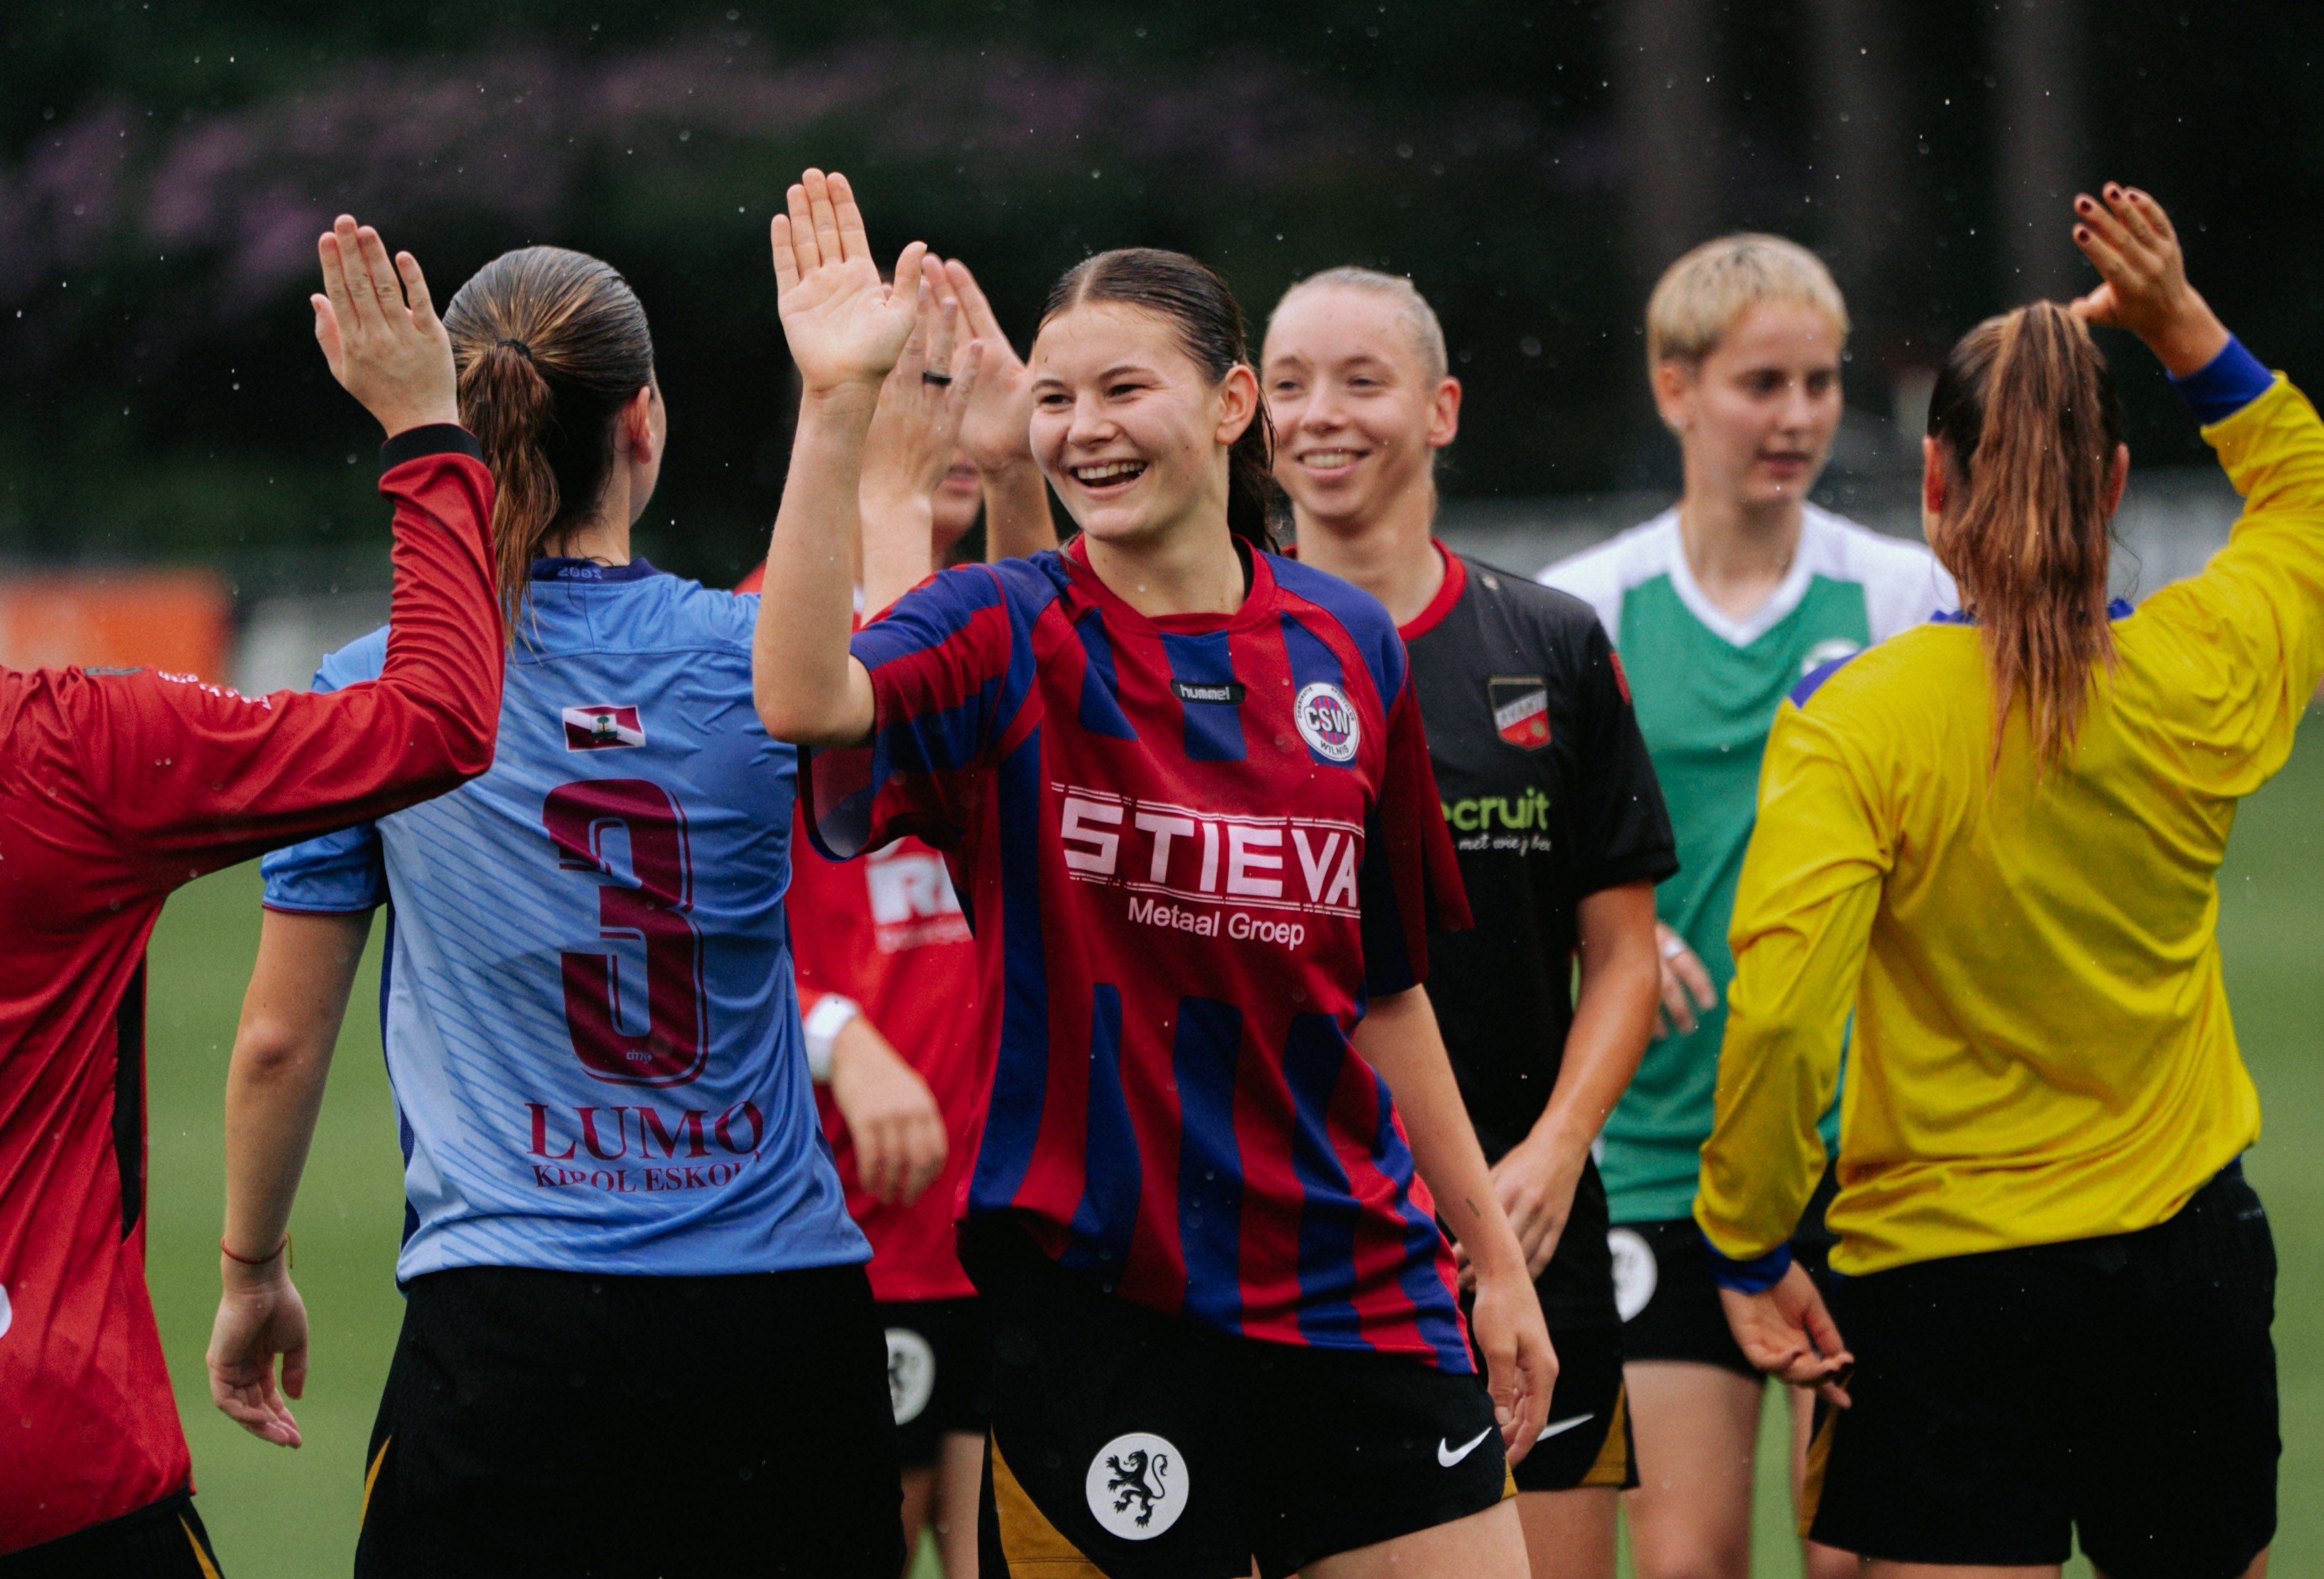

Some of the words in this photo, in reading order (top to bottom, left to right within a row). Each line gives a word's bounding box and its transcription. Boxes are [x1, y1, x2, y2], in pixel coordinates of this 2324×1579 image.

[1179, 684, 1230, 700] hummel
[1304, 706, 1350, 735] CSW
[1320, 740, 1349, 756] WILNIS
[1061, 797, 1358, 908] STIEVA
[543, 779, 709, 1089] 3
[1128, 898, 1221, 937] Metaal
[1228, 913, 1305, 951] Groep
[524, 1100, 764, 1161] LUMO
[643, 1159, 751, 1193] ESKO
